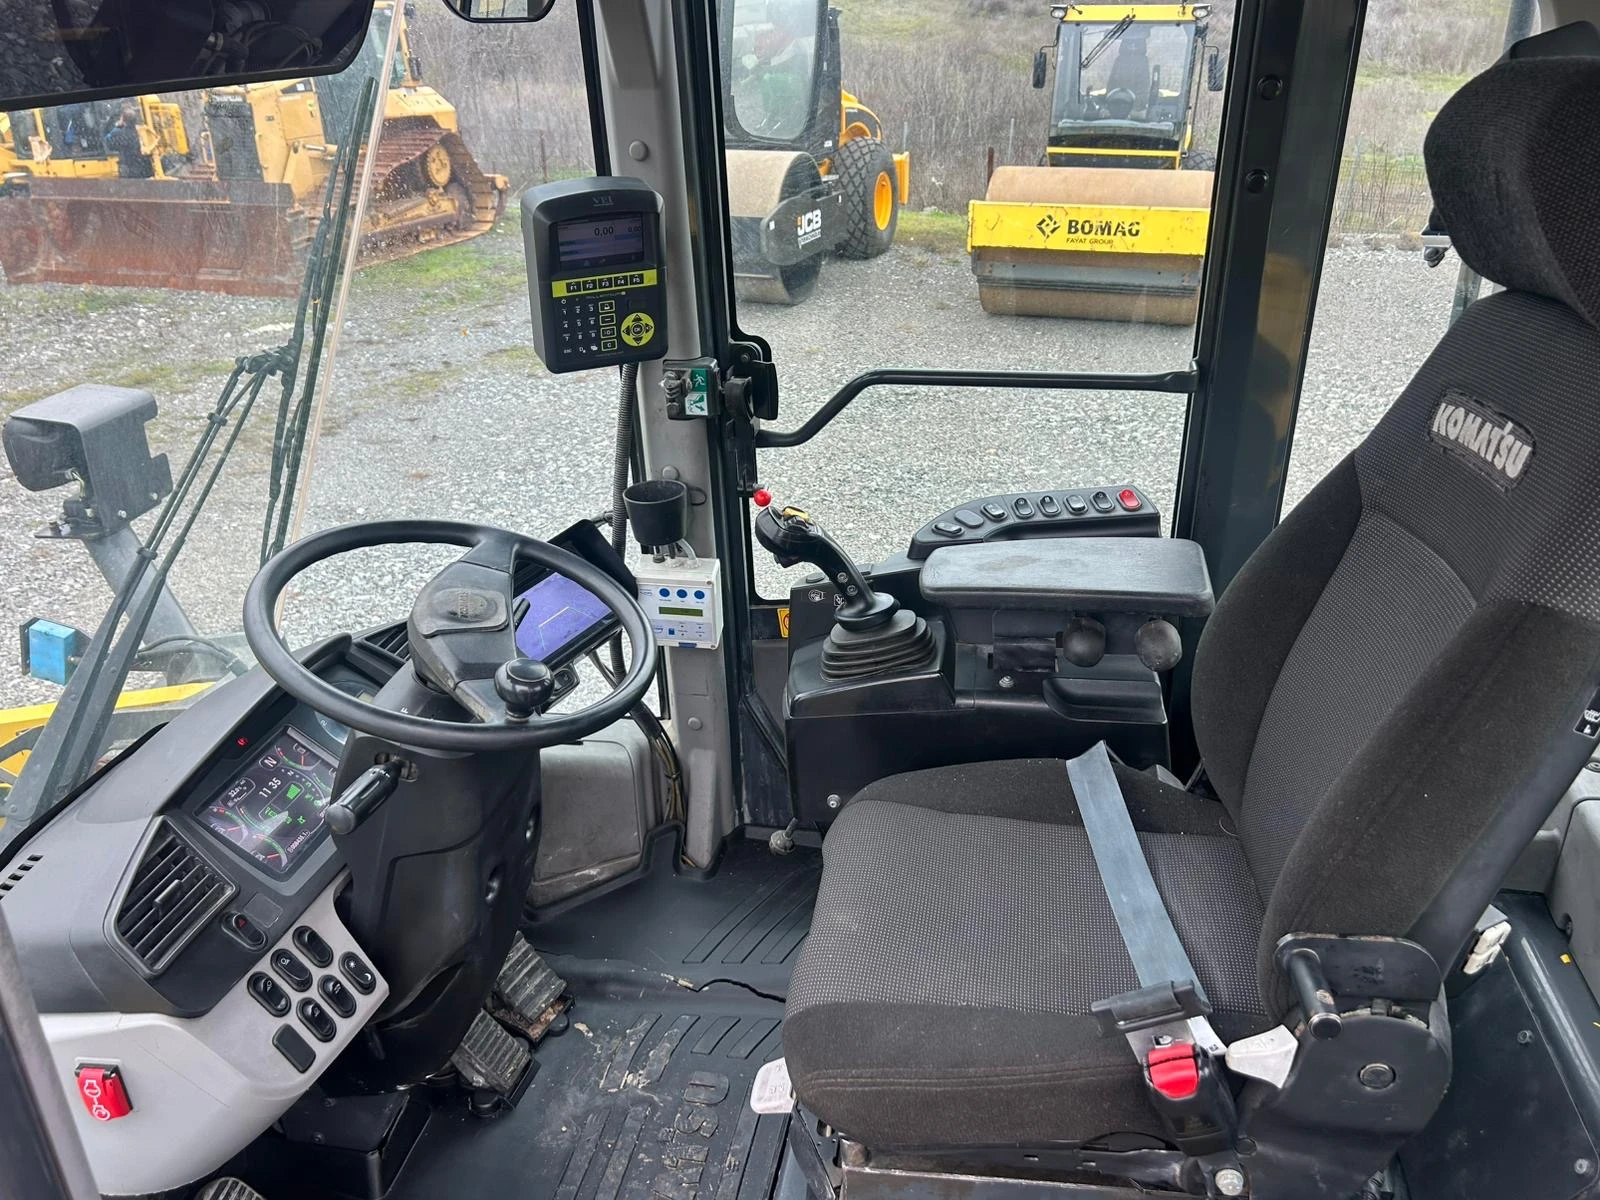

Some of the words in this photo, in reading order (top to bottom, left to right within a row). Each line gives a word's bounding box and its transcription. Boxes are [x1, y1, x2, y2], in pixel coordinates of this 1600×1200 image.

[797, 208, 822, 236] JCB
[1067, 219, 1141, 237] BOMAG
[1432, 403, 1532, 478] KOMATSU
[263, 756, 277, 768] N
